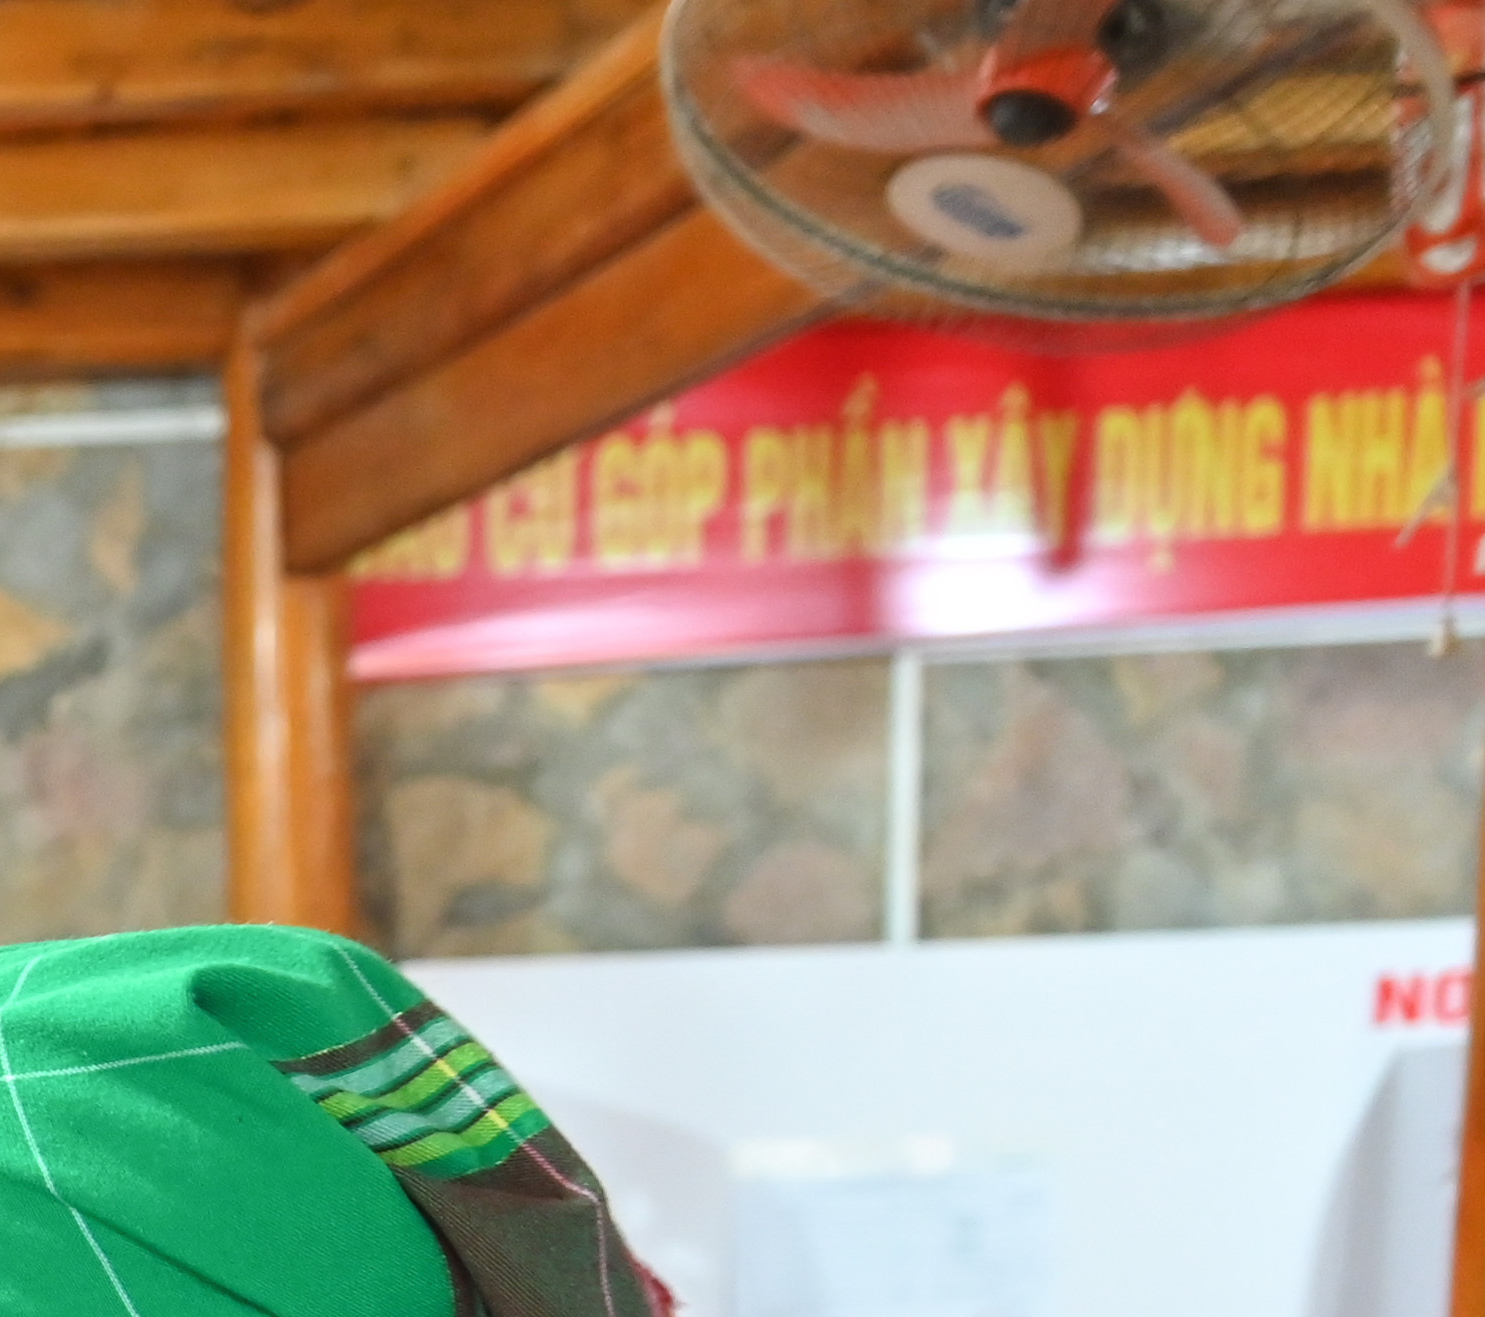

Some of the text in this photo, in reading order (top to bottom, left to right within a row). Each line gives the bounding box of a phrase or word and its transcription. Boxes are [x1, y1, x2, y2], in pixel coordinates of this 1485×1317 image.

[591, 399, 729, 570] GÓP
[946, 384, 1081, 552] XÂY
[1096, 385, 1286, 571] DỰNG
